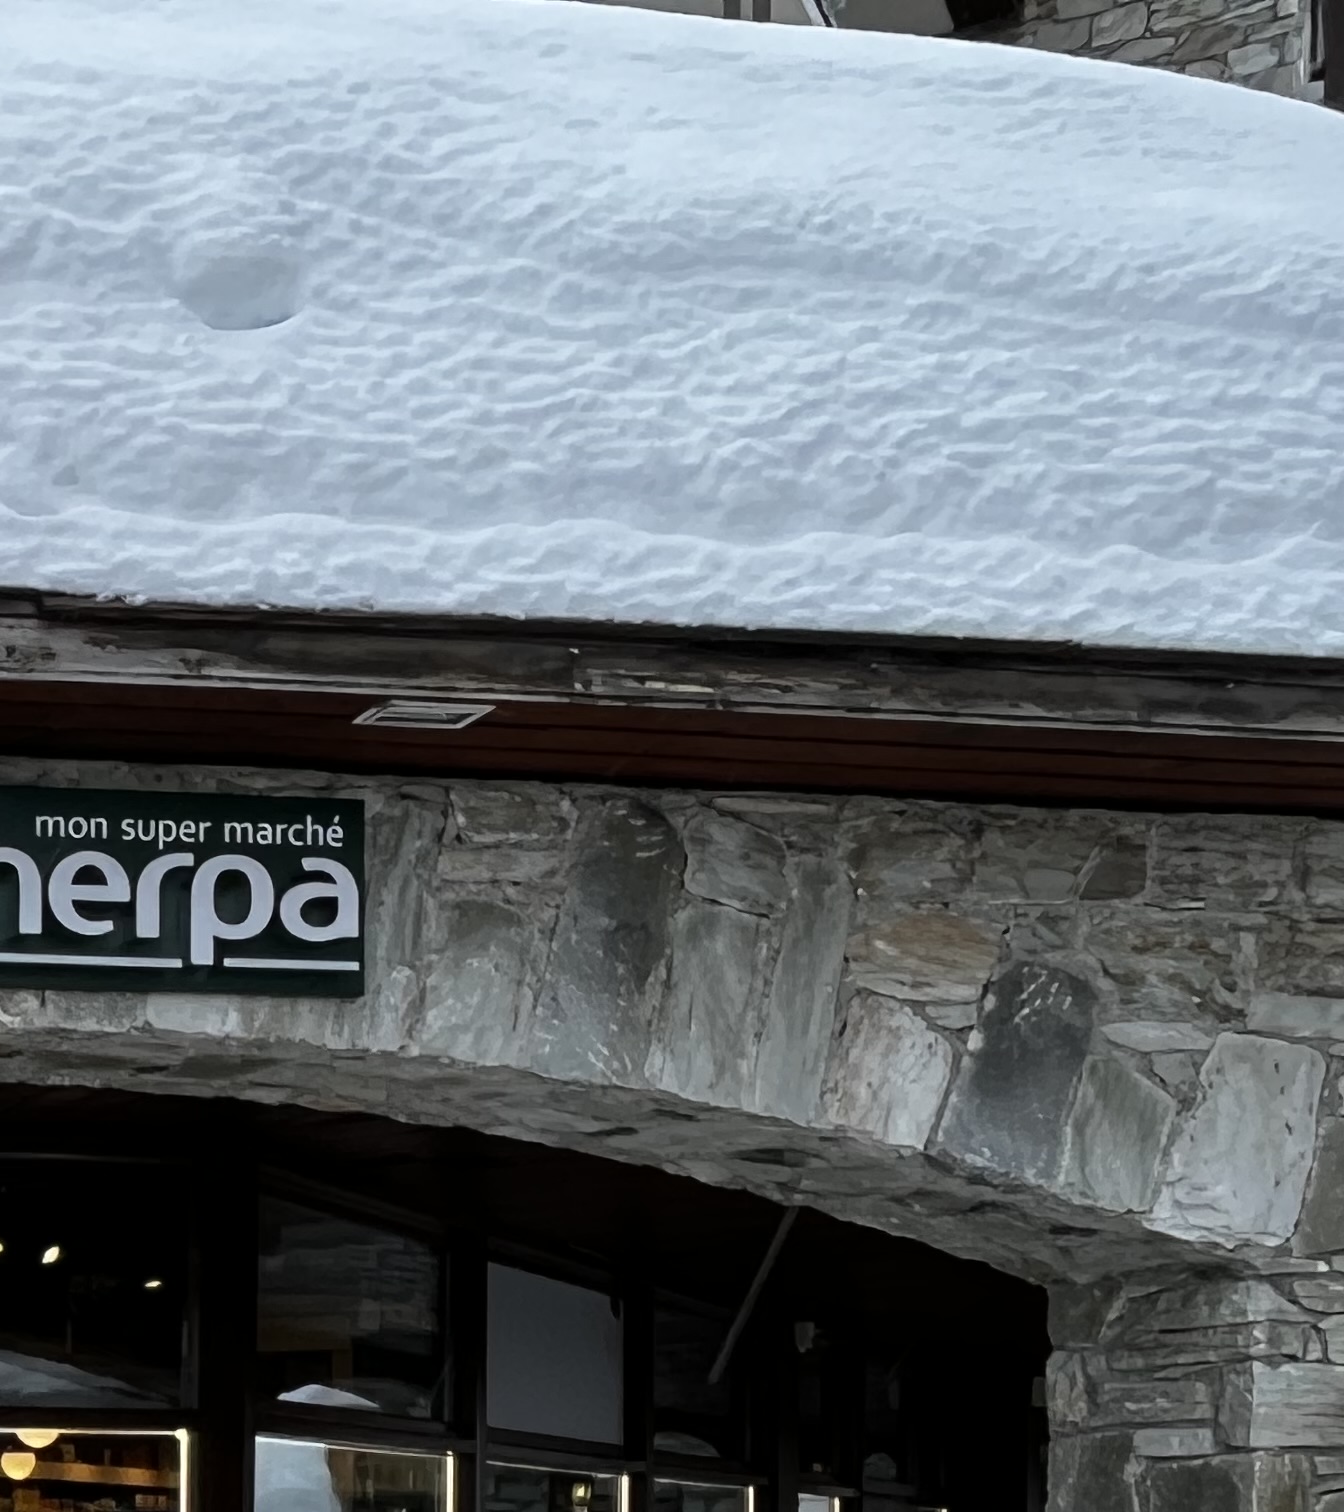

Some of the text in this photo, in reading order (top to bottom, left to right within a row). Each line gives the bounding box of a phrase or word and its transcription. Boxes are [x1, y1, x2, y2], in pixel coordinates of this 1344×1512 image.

[35, 814, 345, 849] mon super marché
